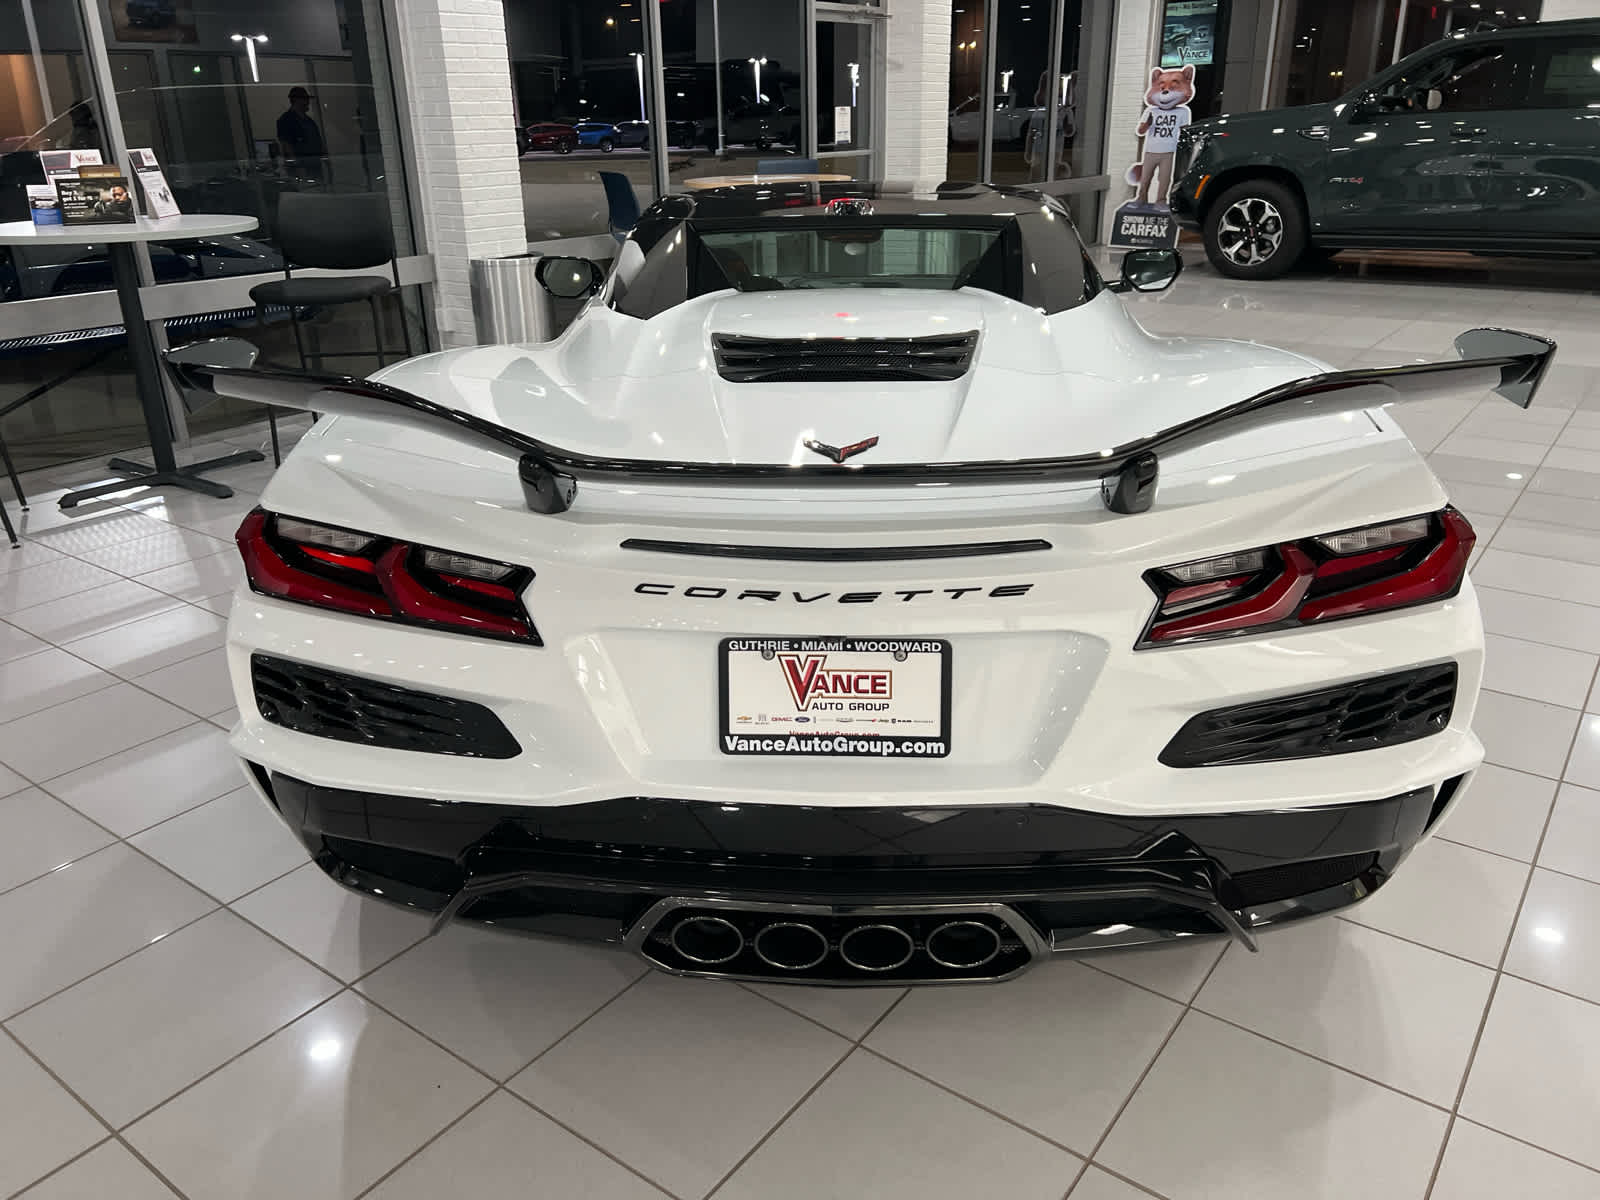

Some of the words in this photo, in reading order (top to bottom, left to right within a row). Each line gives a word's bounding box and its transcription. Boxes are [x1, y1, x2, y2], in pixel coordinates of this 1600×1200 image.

[1177, 47, 1210, 63] VANCE
[1155, 114, 1177, 126] CAR
[1153, 126, 1175, 138] FOX
[1122, 215, 1145, 224] SHOW
[1120, 223, 1169, 238] CARFAX
[634, 583, 1034, 604] CORVETTE
[728, 640, 790, 651] GUTHRIE
[801, 641, 844, 651] MIAMI
[854, 641, 942, 652] WOODWARD
[780, 656, 890, 709] VANCE
[811, 702, 844, 712] AUTO
[848, 702, 890, 712] GROUP
[724, 736, 946, 756] VanceAutoGroup.com
